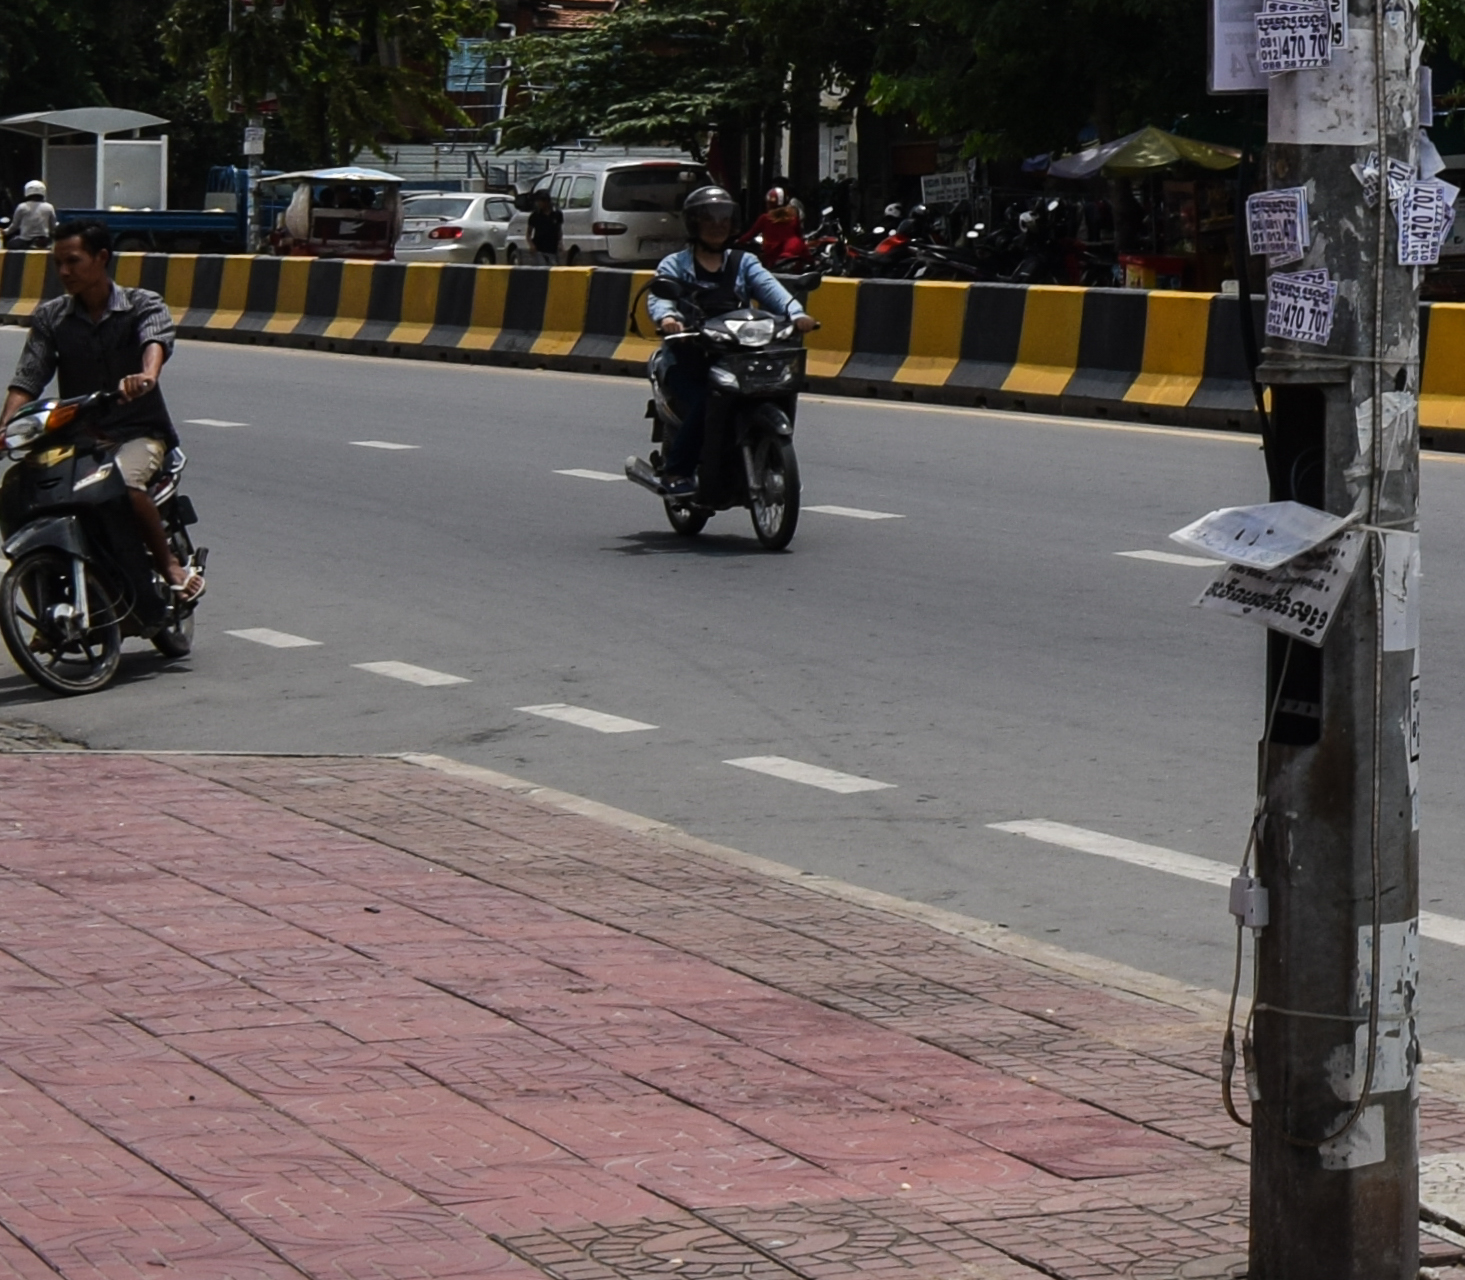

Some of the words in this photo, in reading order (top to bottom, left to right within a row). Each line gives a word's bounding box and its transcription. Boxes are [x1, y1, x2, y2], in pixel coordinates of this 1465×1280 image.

[1260, 37, 1278, 48] 081
[1282, 35, 1306, 59] 470
[1261, 49, 1279, 60] 012
[1299, 59, 1319, 67] 777
[1413, 187, 1435, 211] 707
[1434, 205, 1443, 225] 777
[1411, 215, 1433, 239] 470
[1411, 243, 1420, 261] 081
[1420, 242, 1430, 261] 012
[1283, 303, 1305, 329] 470
[1308, 308, 1328, 334] 707
[1294, 330, 1314, 340] 777
